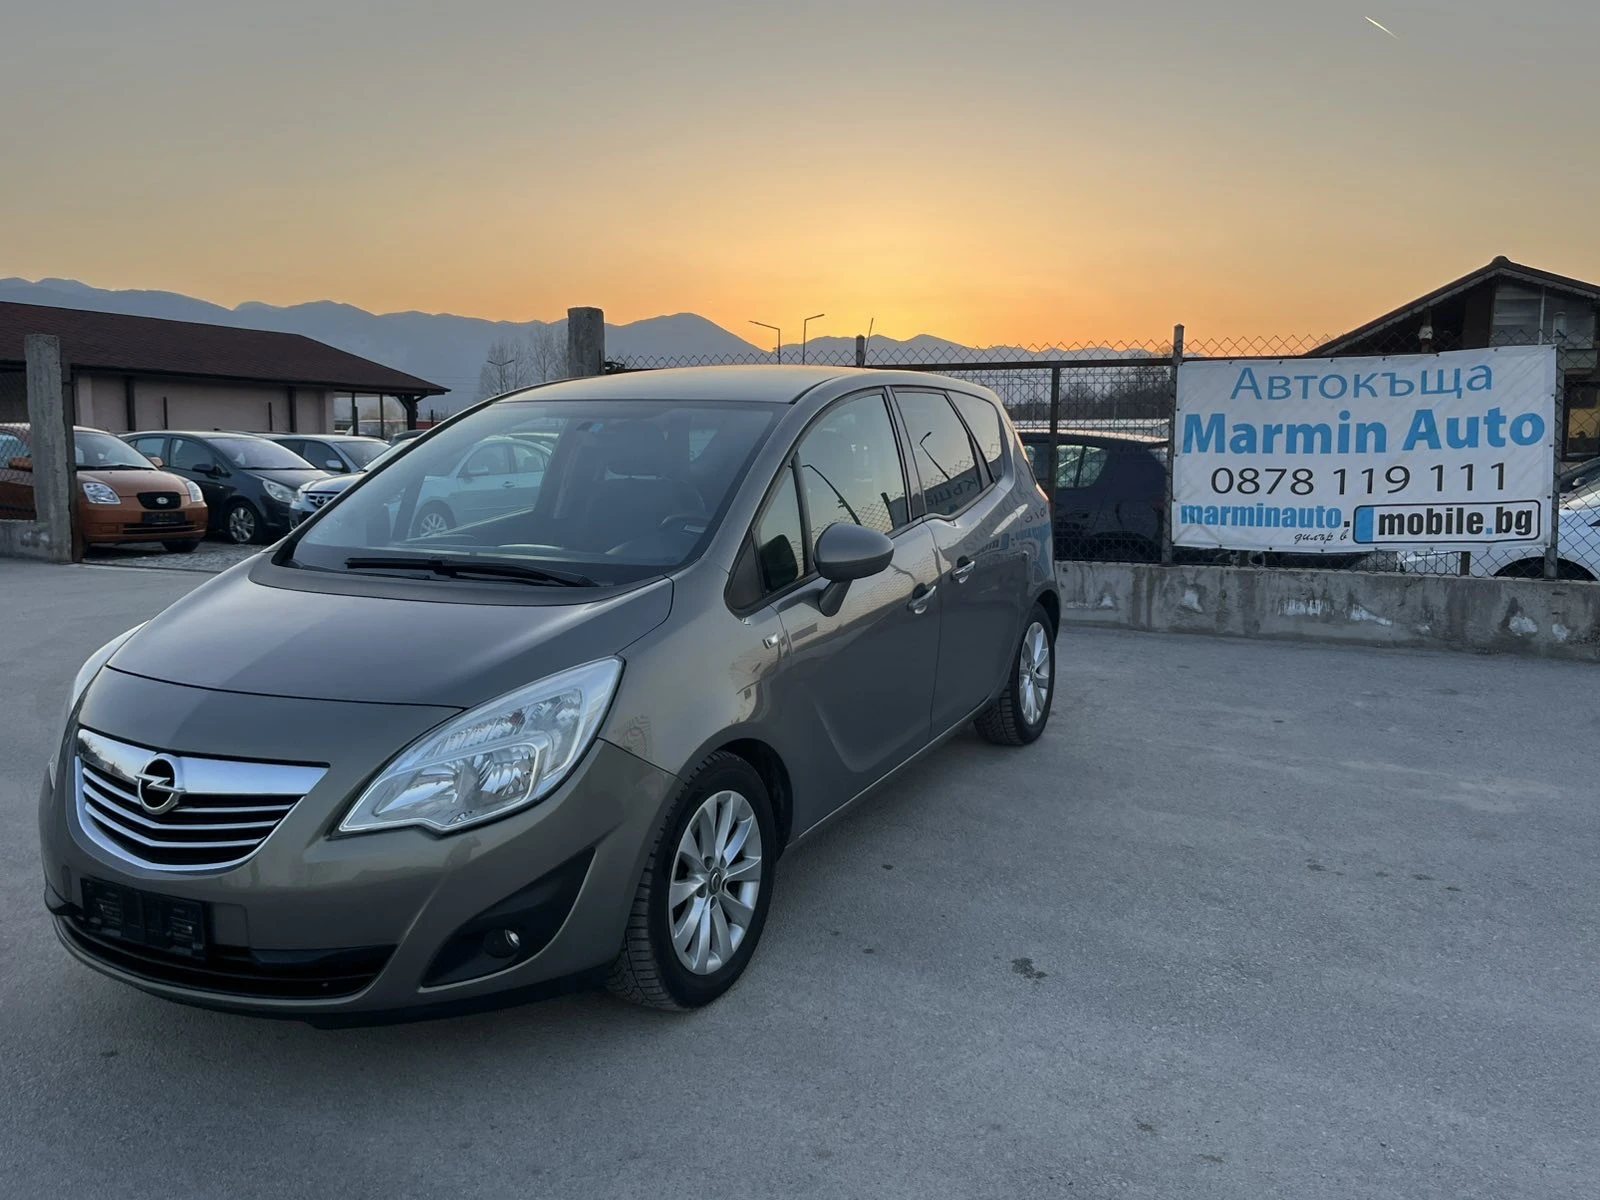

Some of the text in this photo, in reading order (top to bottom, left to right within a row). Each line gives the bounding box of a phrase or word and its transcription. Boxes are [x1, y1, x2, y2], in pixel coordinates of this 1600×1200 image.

[1230, 365, 1492, 400] Автокъща
[1182, 407, 1545, 454] Marmin Auto
[1211, 462, 1506, 495] 0878 119 111
[1378, 506, 1533, 536] mobile.bg
